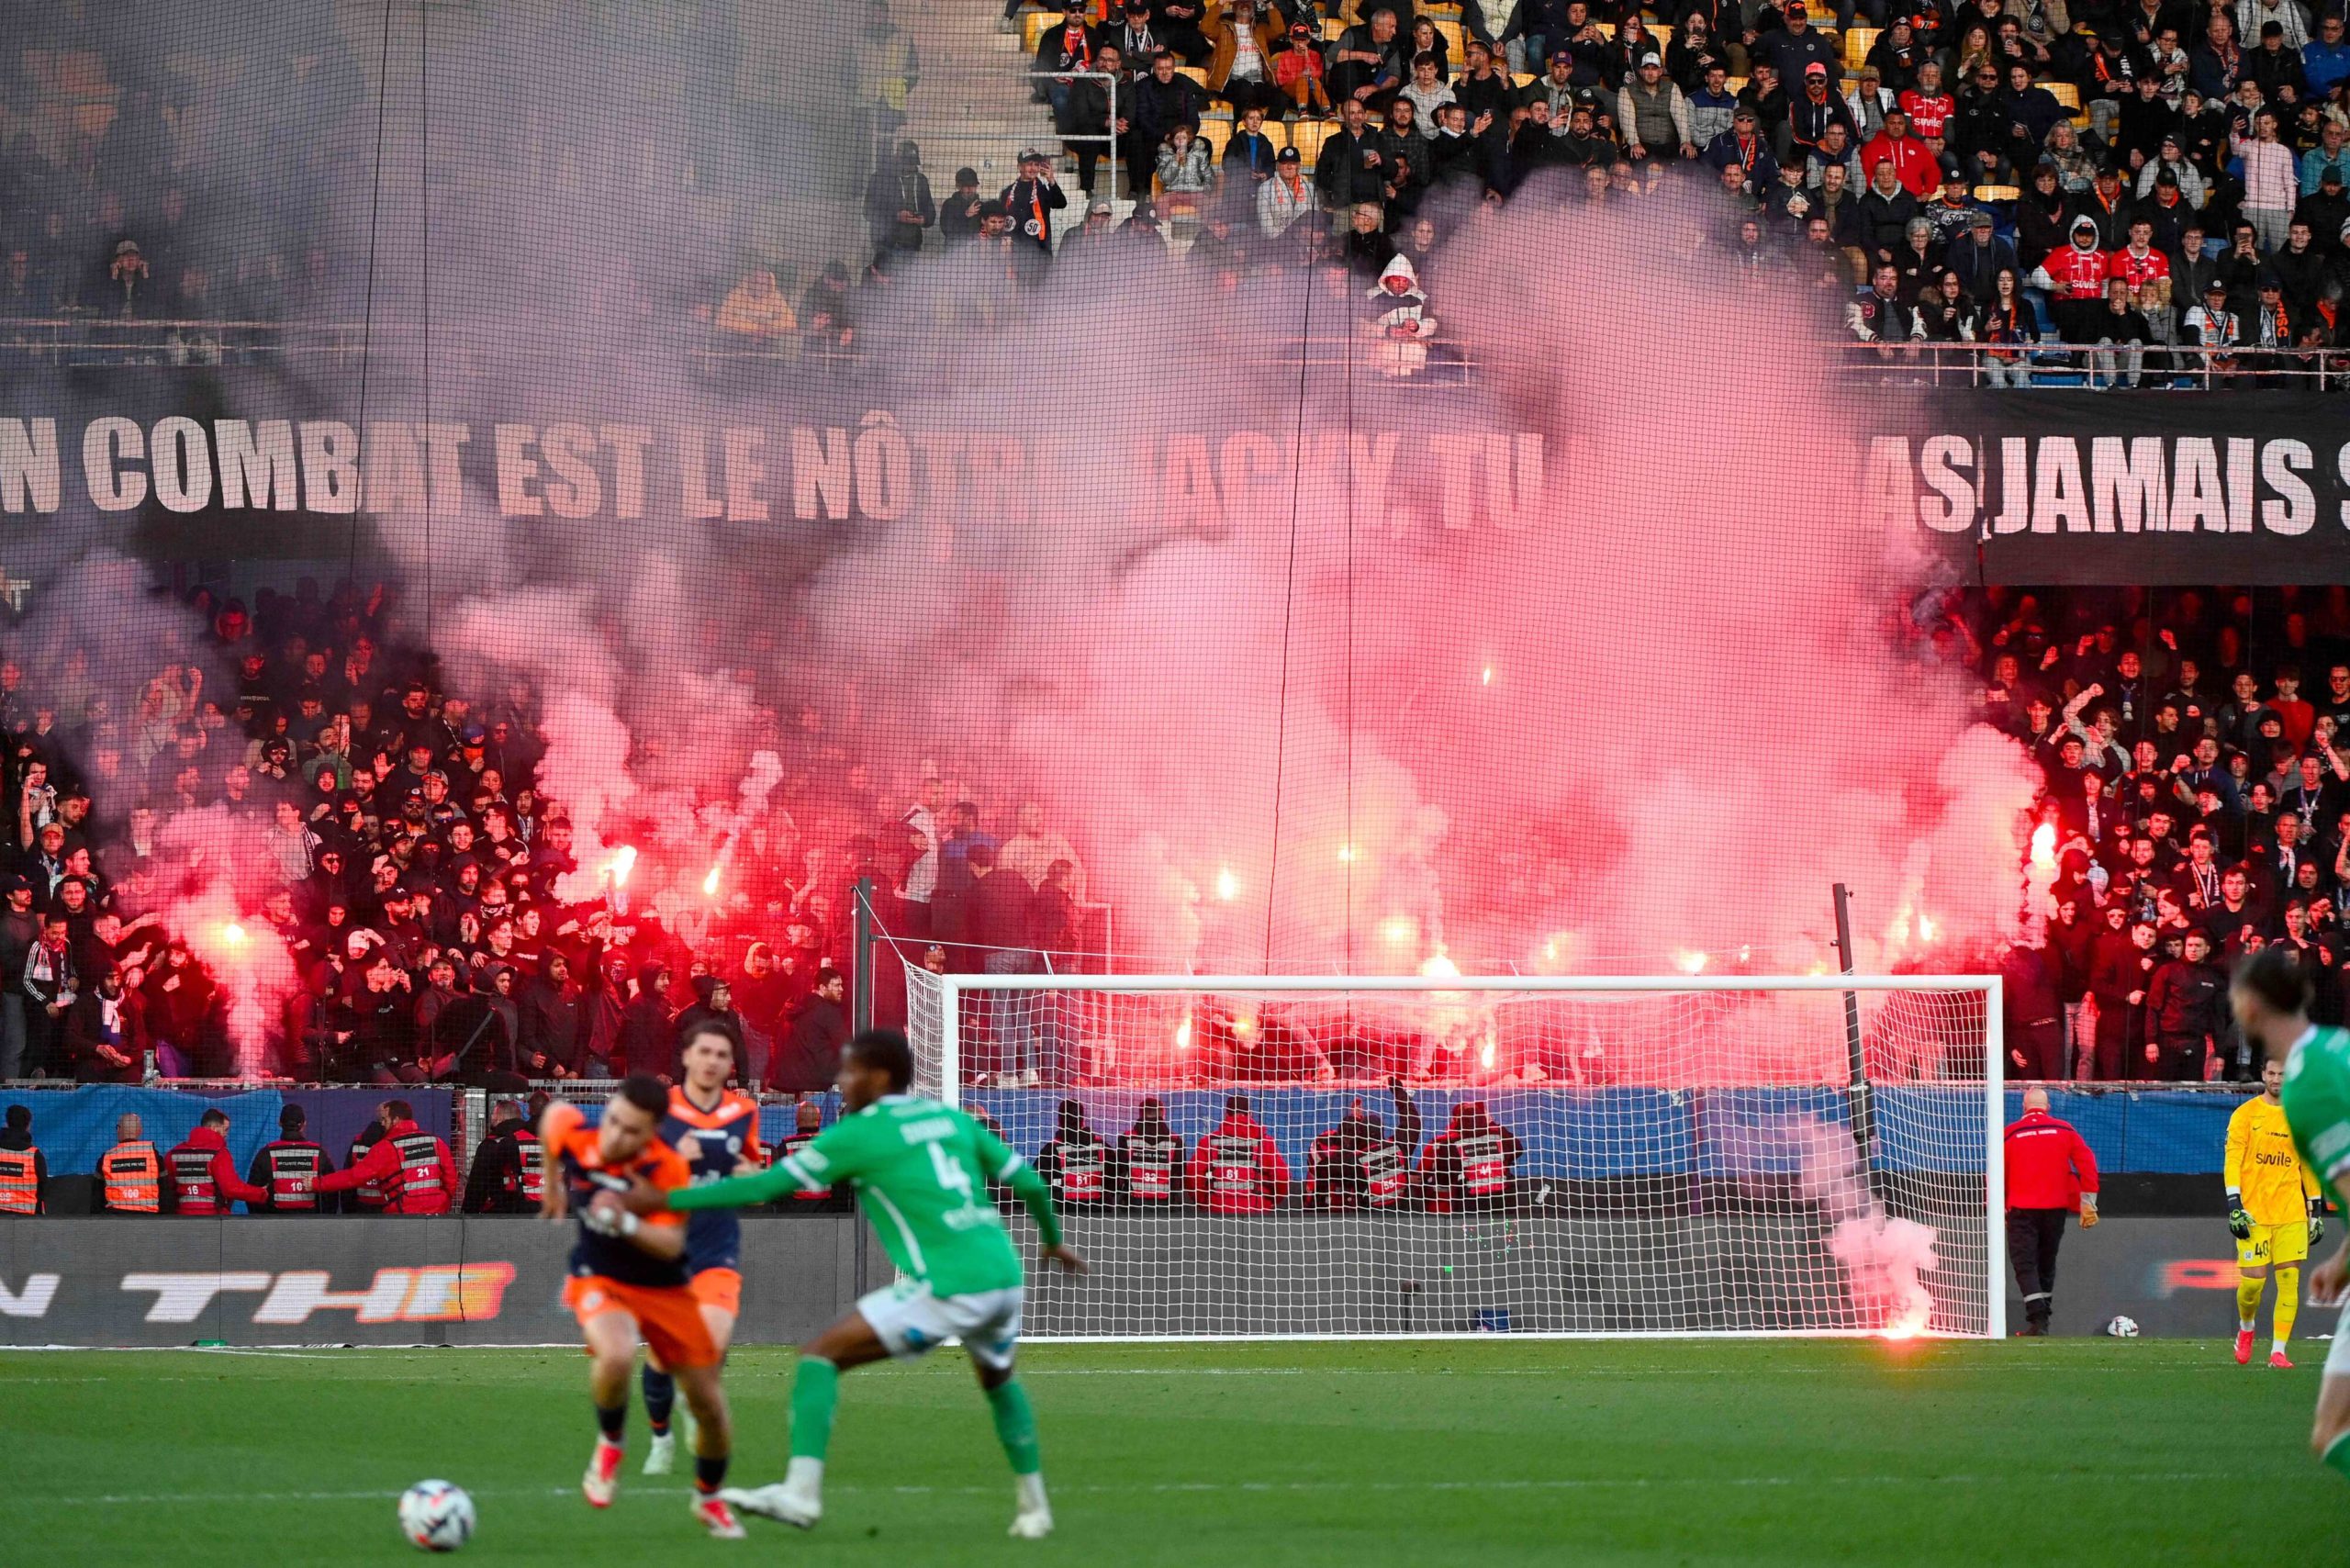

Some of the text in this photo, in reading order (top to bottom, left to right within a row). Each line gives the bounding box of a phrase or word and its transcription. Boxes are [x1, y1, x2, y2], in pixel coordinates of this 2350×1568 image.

[1027, 222, 1038, 232] 50
[83, 415, 470, 515] COMBAT
[493, 422, 653, 521] EST
[679, 426, 770, 521] LE
[1430, 432, 1544, 531] TU
[1993, 436, 2317, 536] JAMAIS
[2255, 1151, 2292, 1168] swile
[417, 1167, 430, 1178] 21
[927, 1140, 974, 1199] 4
[1145, 1172, 1157, 1182] 32
[186, 1184, 199, 1195] 16
